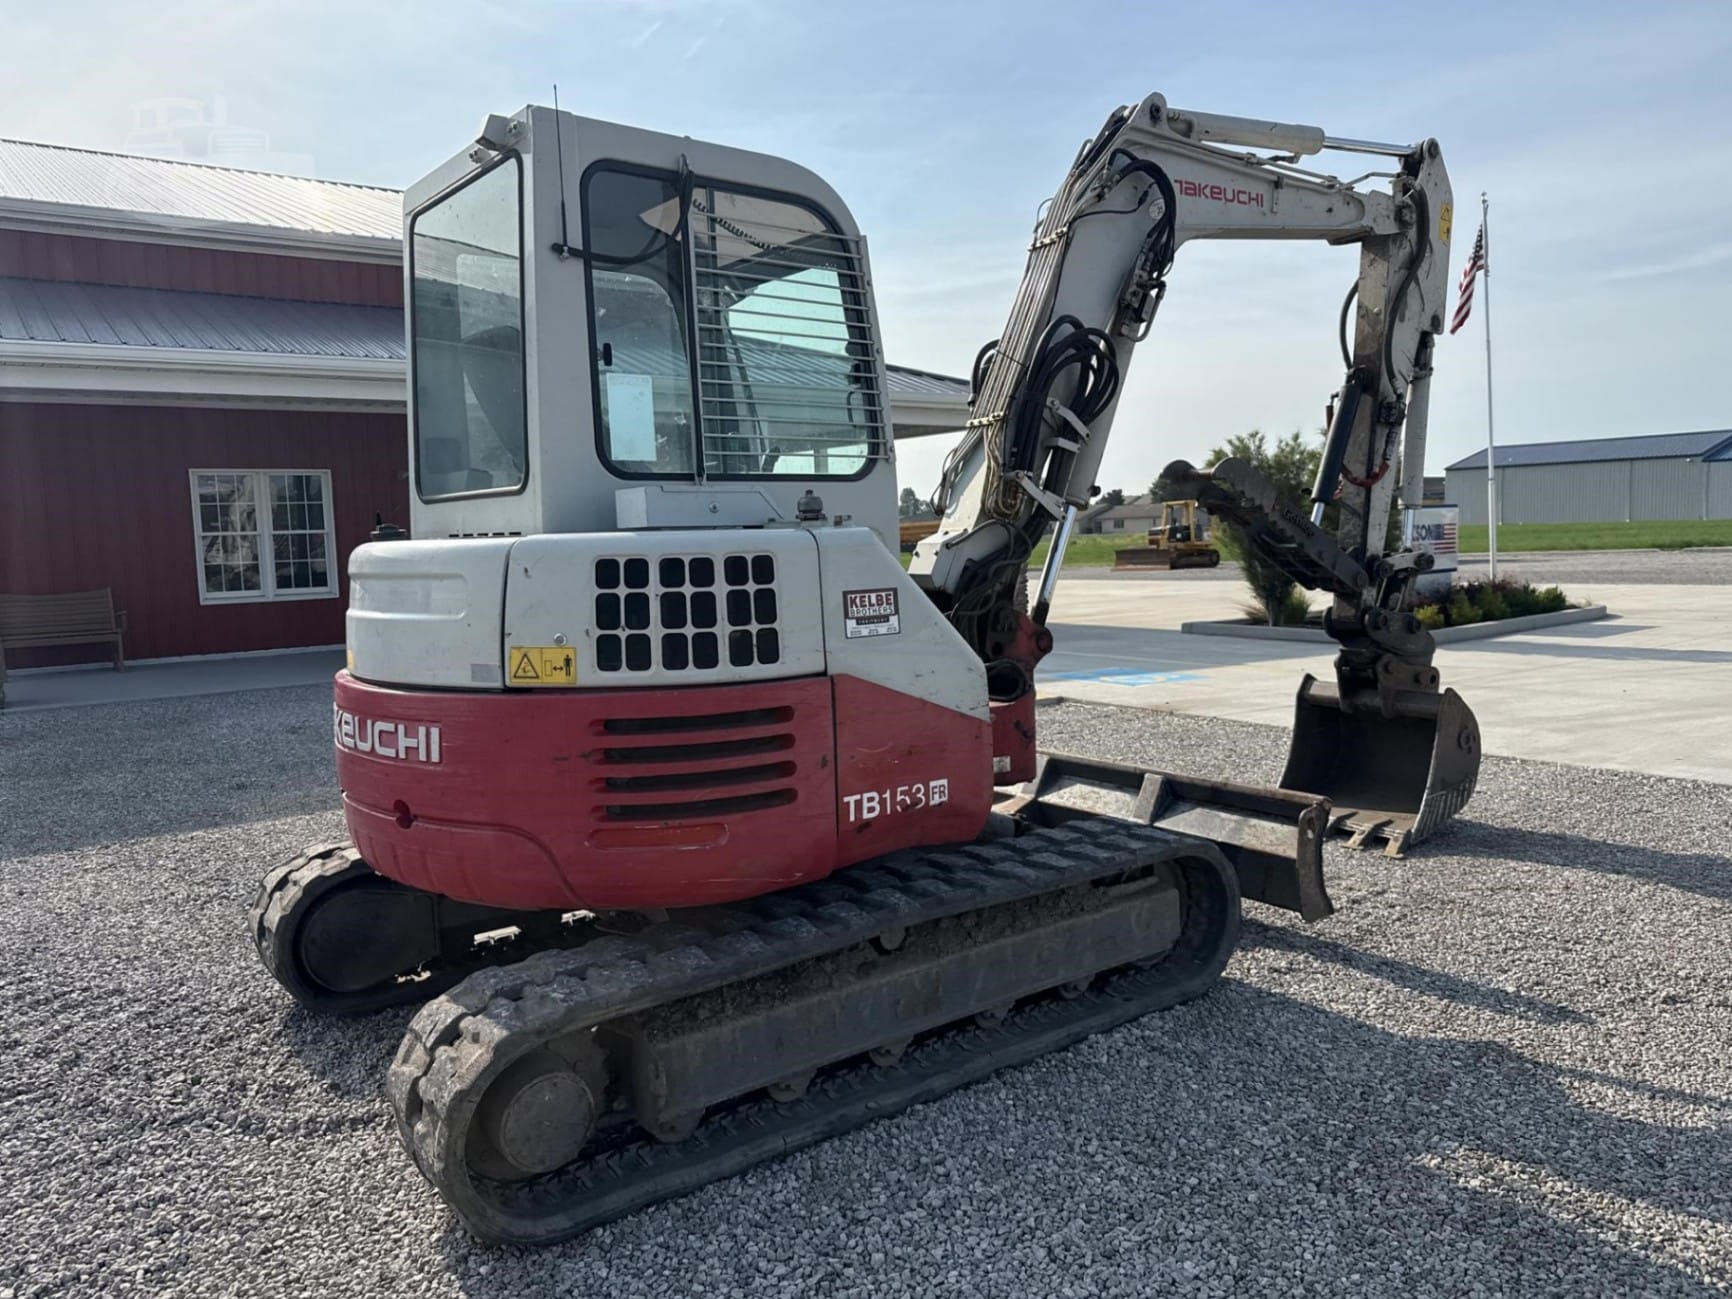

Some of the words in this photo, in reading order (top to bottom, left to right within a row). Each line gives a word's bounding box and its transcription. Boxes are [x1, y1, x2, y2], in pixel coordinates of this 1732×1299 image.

[849, 593, 893, 608] KELBE
[850, 606, 893, 617] BROTHERS
[843, 783, 926, 822] TB153
[930, 782, 947, 804] FR
